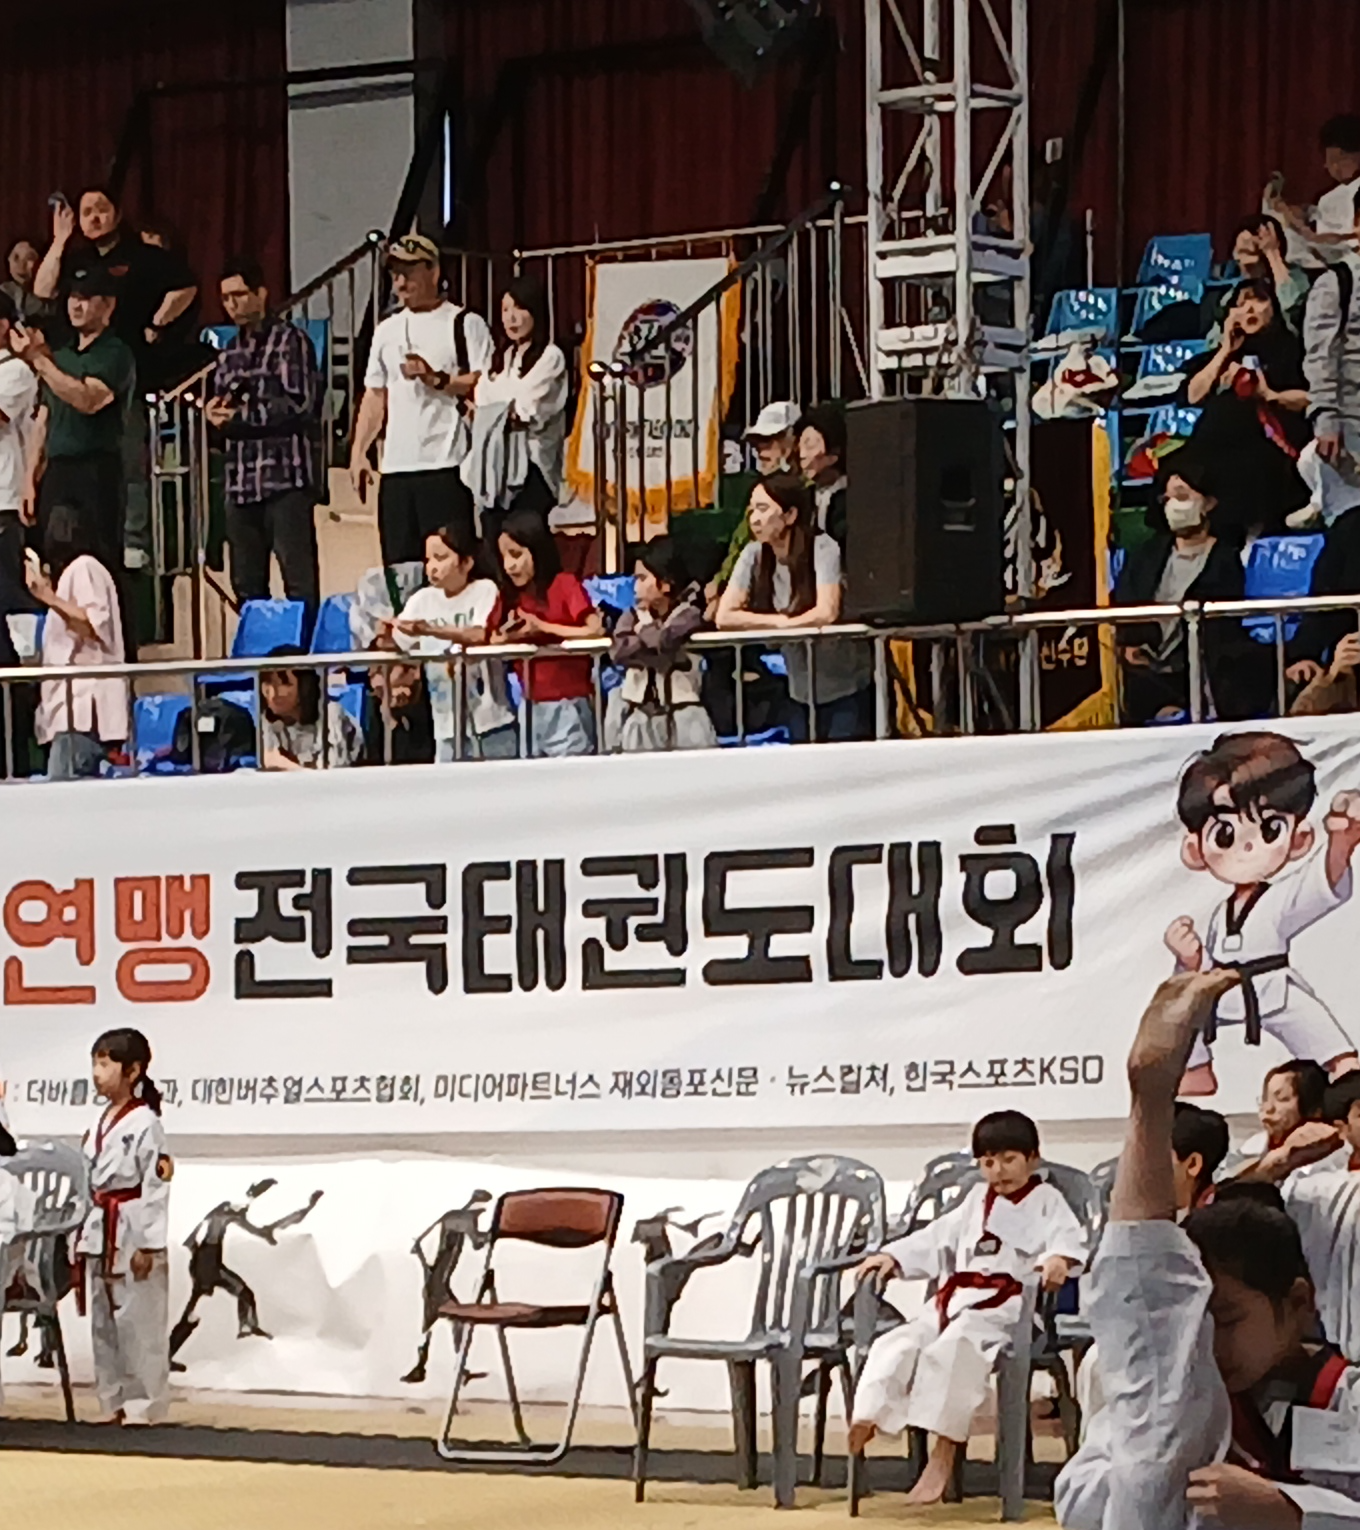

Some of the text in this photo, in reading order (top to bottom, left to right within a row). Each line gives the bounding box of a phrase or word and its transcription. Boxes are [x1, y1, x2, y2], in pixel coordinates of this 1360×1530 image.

[233, 823, 1078, 999] 전국태권도대회
[433, 1070, 601, 1103] 미디어파트너스
[904, 1054, 1104, 1093] 한국스포츠KSO
